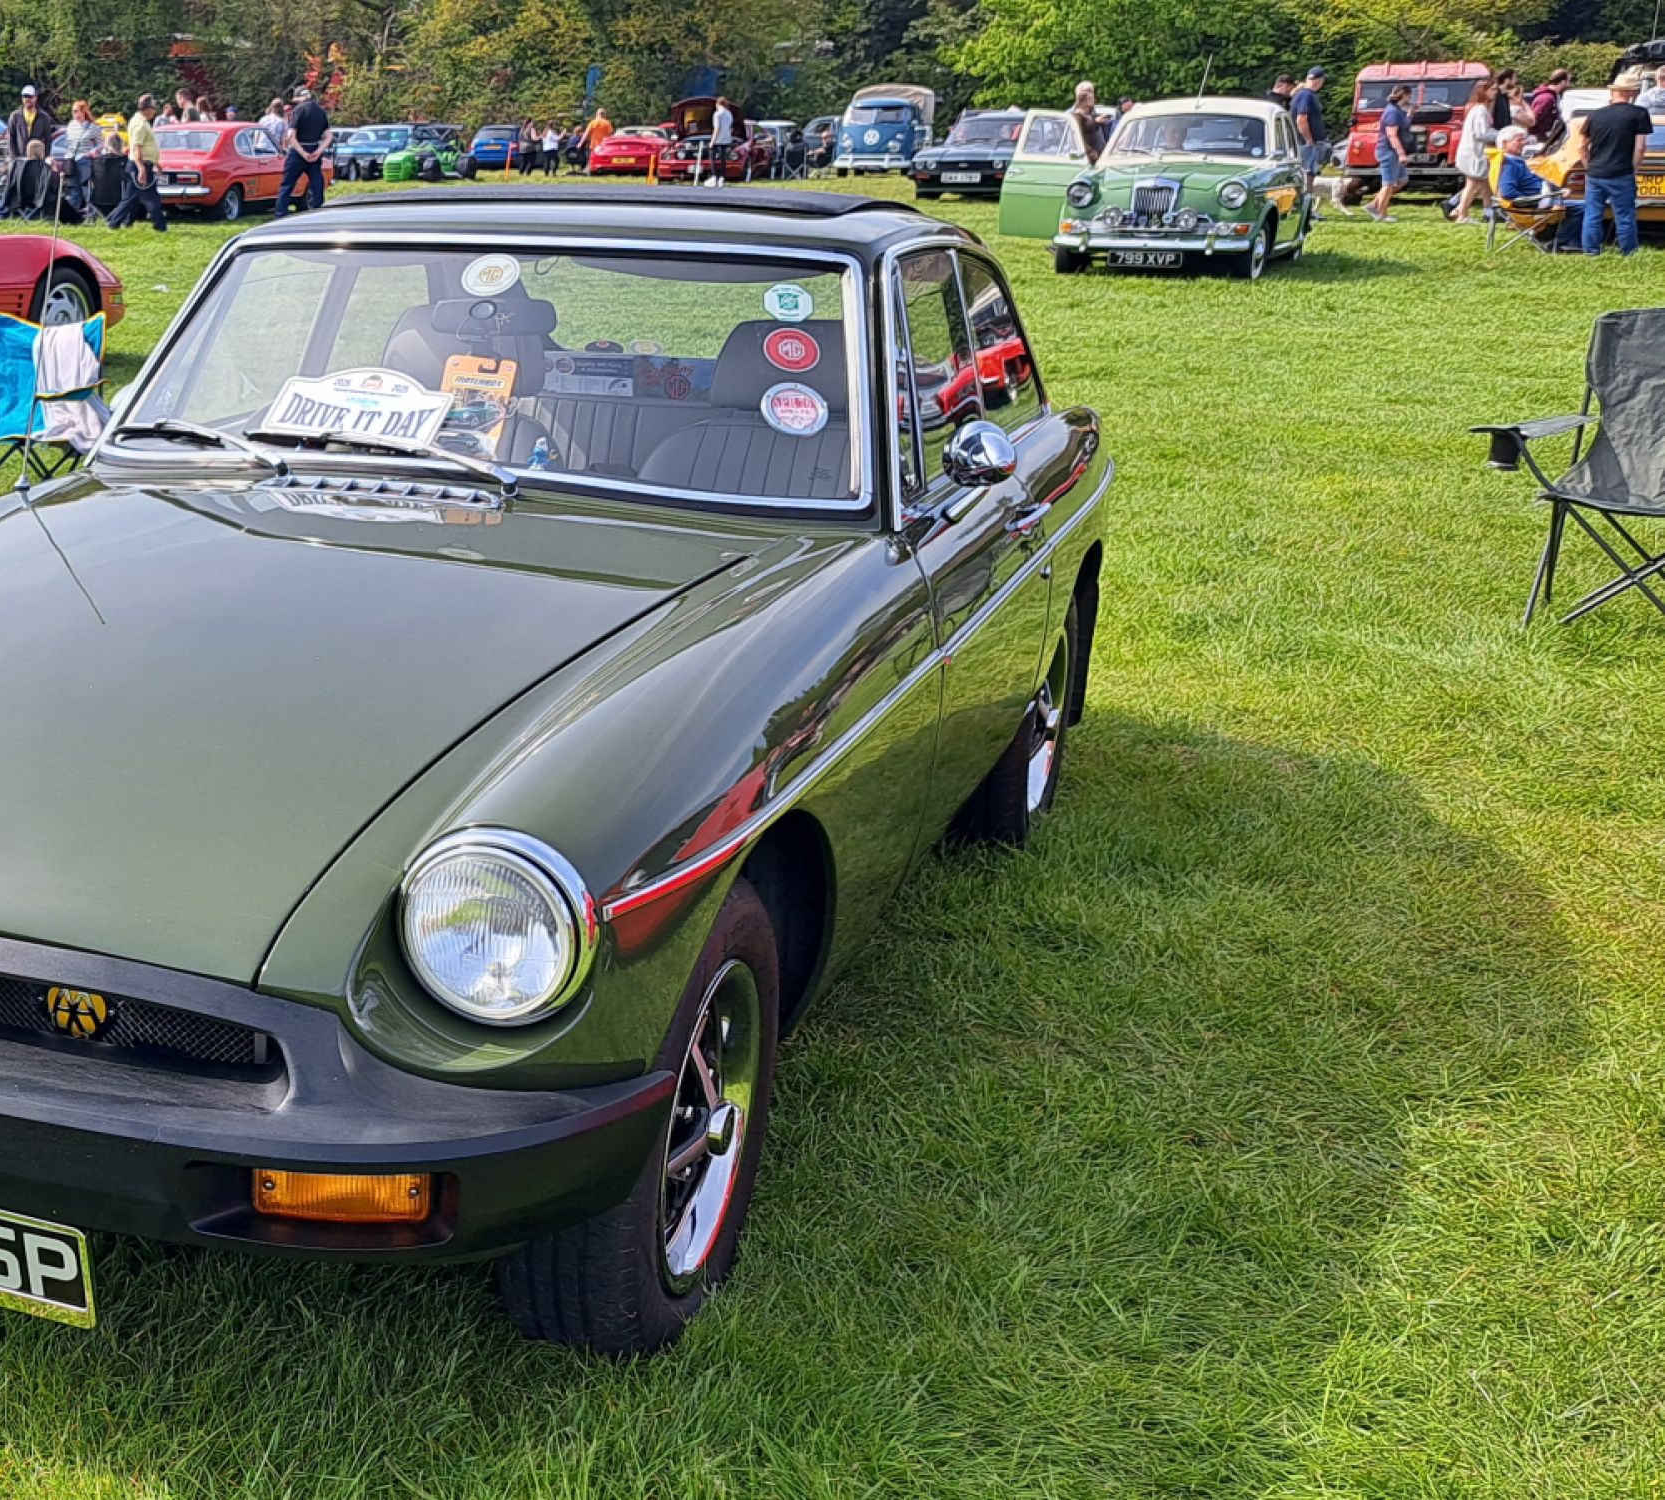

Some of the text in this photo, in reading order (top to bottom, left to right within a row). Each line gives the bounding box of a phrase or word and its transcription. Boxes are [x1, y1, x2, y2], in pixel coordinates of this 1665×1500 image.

[1117, 251, 1143, 264] 799
[781, 340, 803, 360] MG
[278, 393, 437, 438] DRIVE IT DAY
